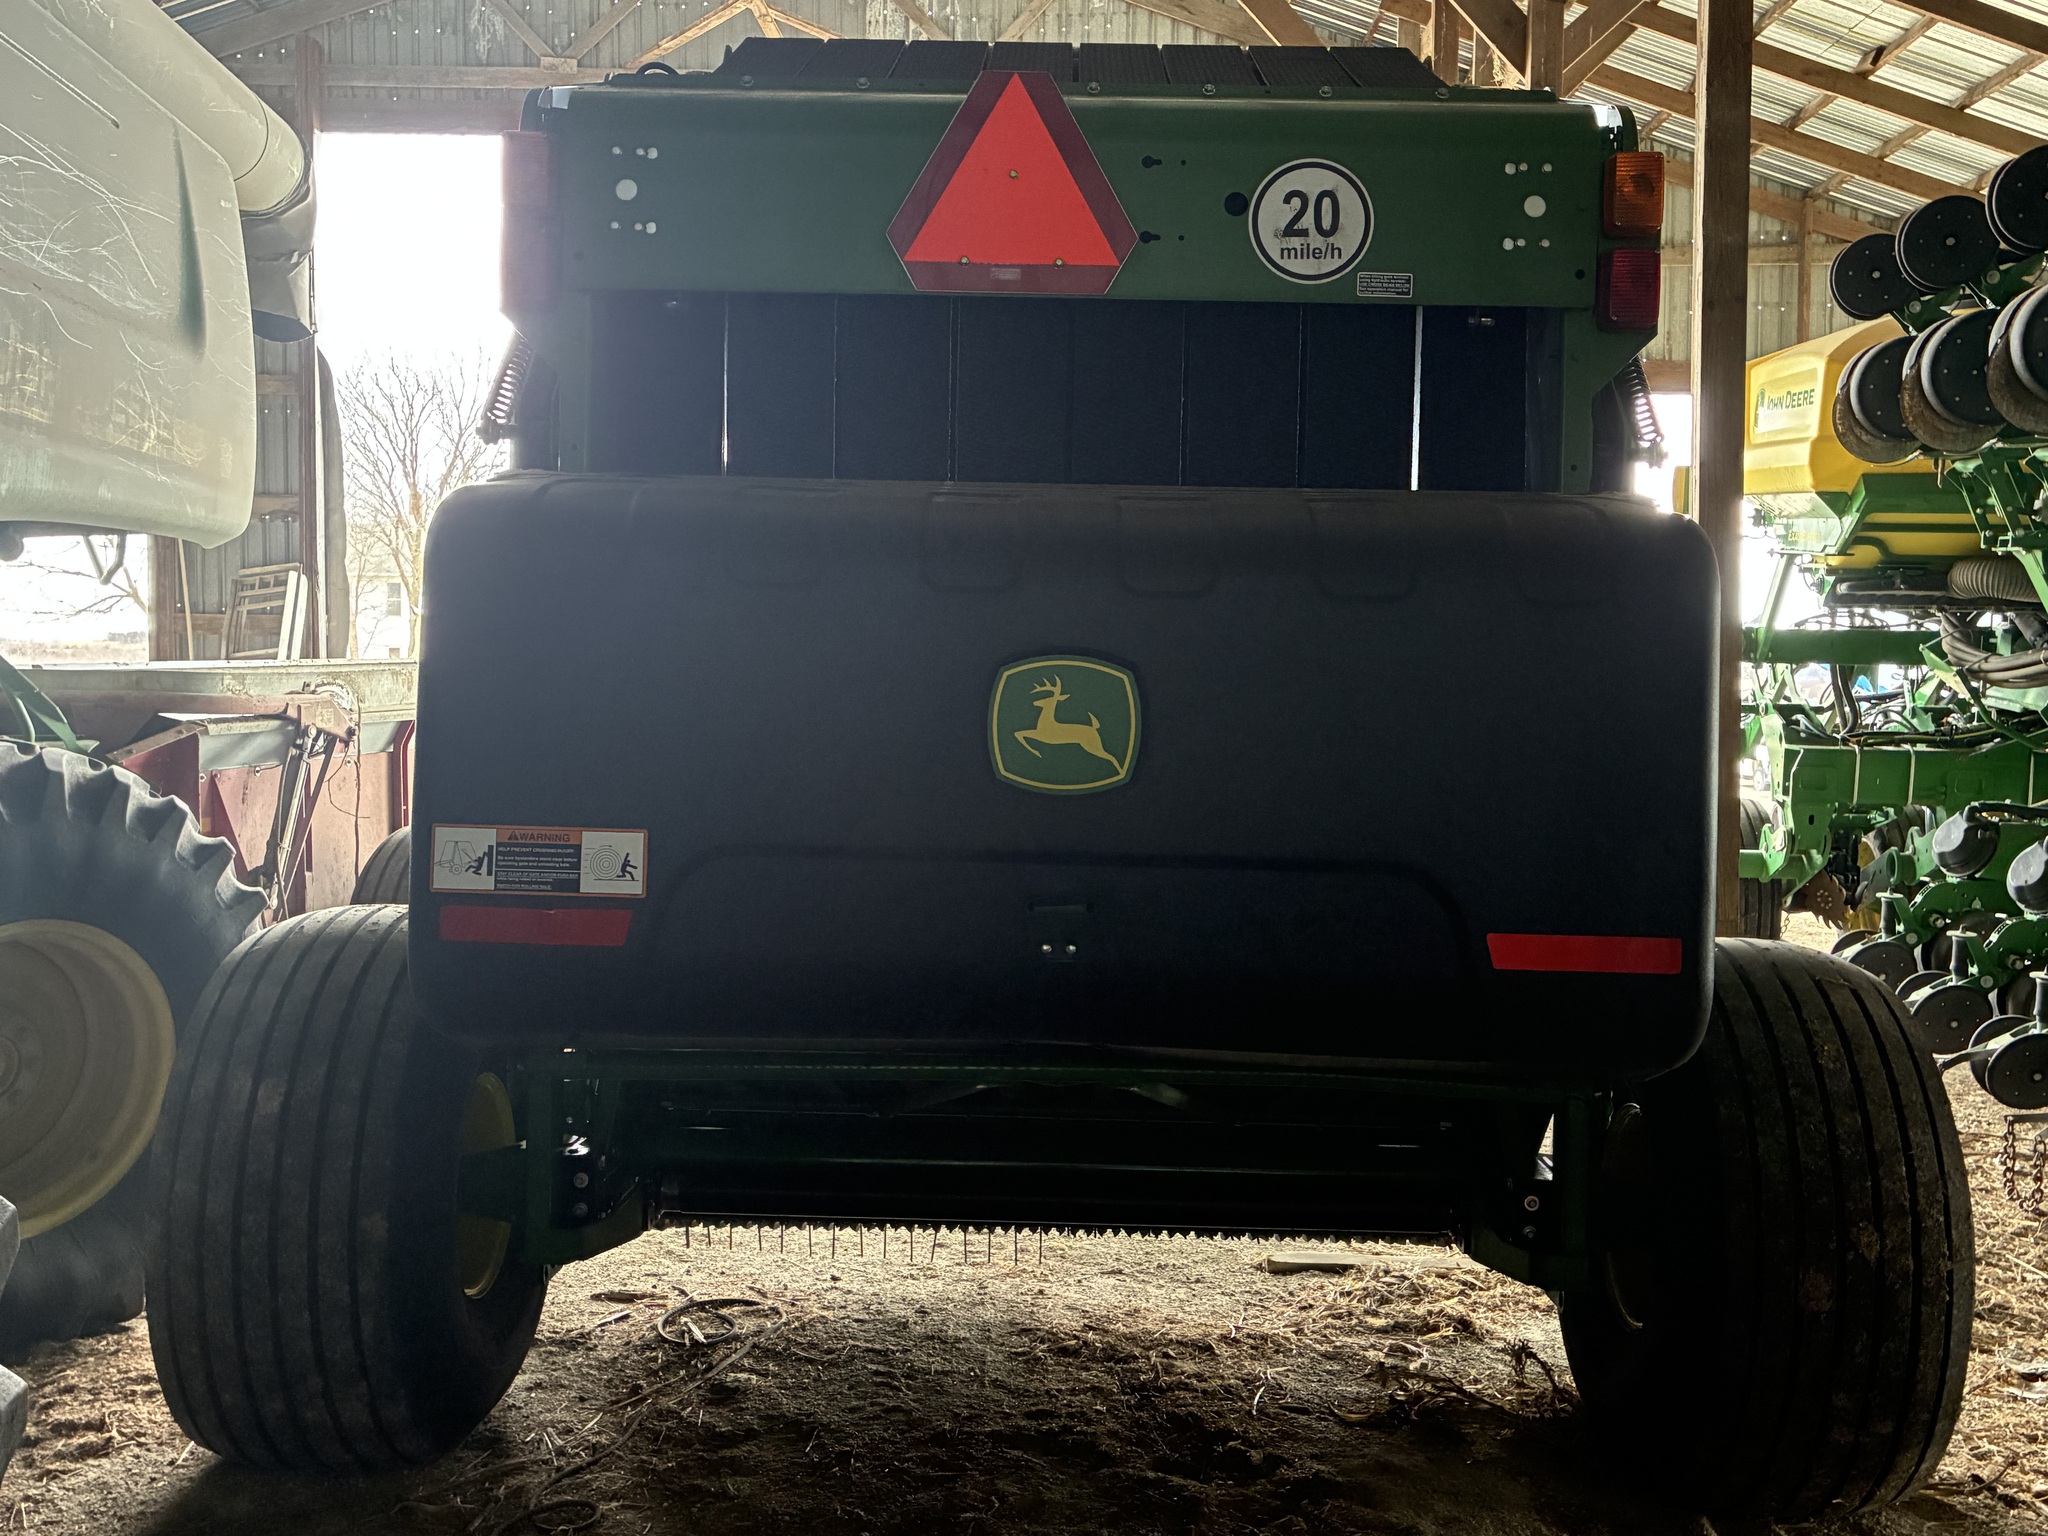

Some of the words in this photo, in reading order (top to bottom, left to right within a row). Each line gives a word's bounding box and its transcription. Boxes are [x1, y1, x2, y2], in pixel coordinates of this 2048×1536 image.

[1282, 189, 1341, 239] 20
[1280, 242, 1342, 260] mile/h
[1785, 388, 1815, 409] DEERE
[520, 832, 570, 842] WARNING
